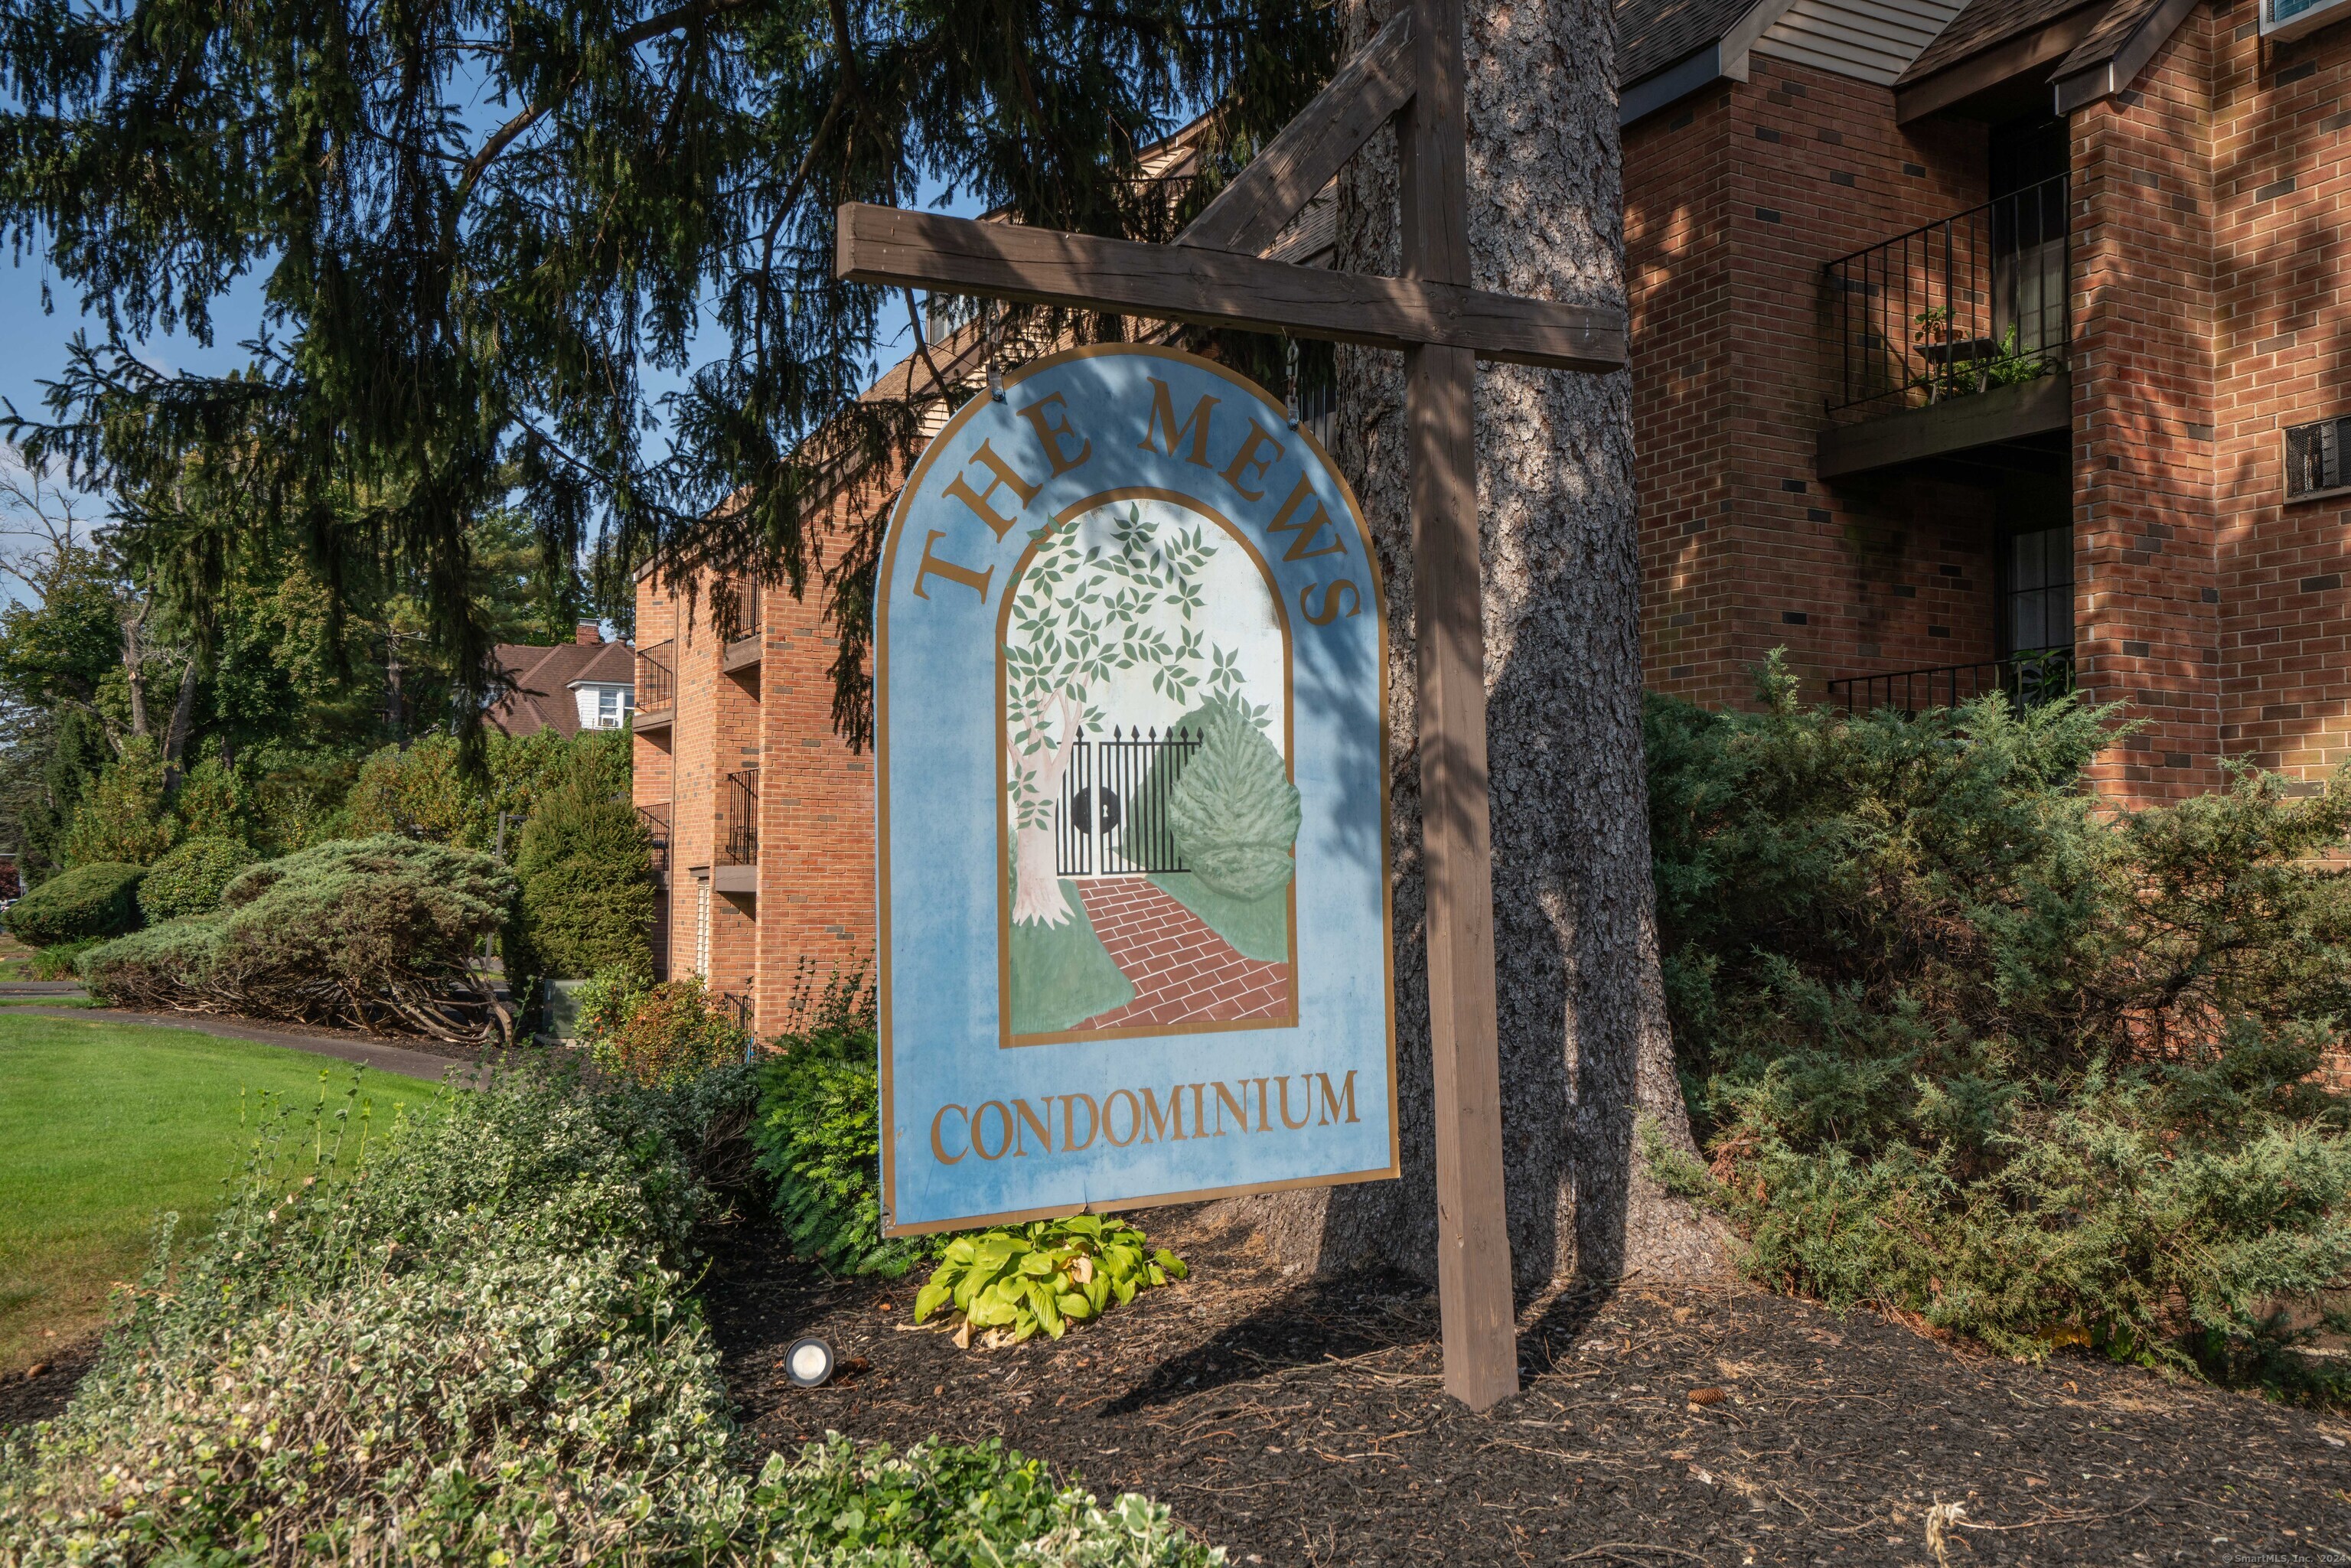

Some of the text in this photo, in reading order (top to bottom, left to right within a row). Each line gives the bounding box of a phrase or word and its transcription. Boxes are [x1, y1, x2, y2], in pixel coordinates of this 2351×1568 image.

[913, 376, 1362, 628] THE MEWS
[931, 1069, 1361, 1165] CONDOMINIUM
